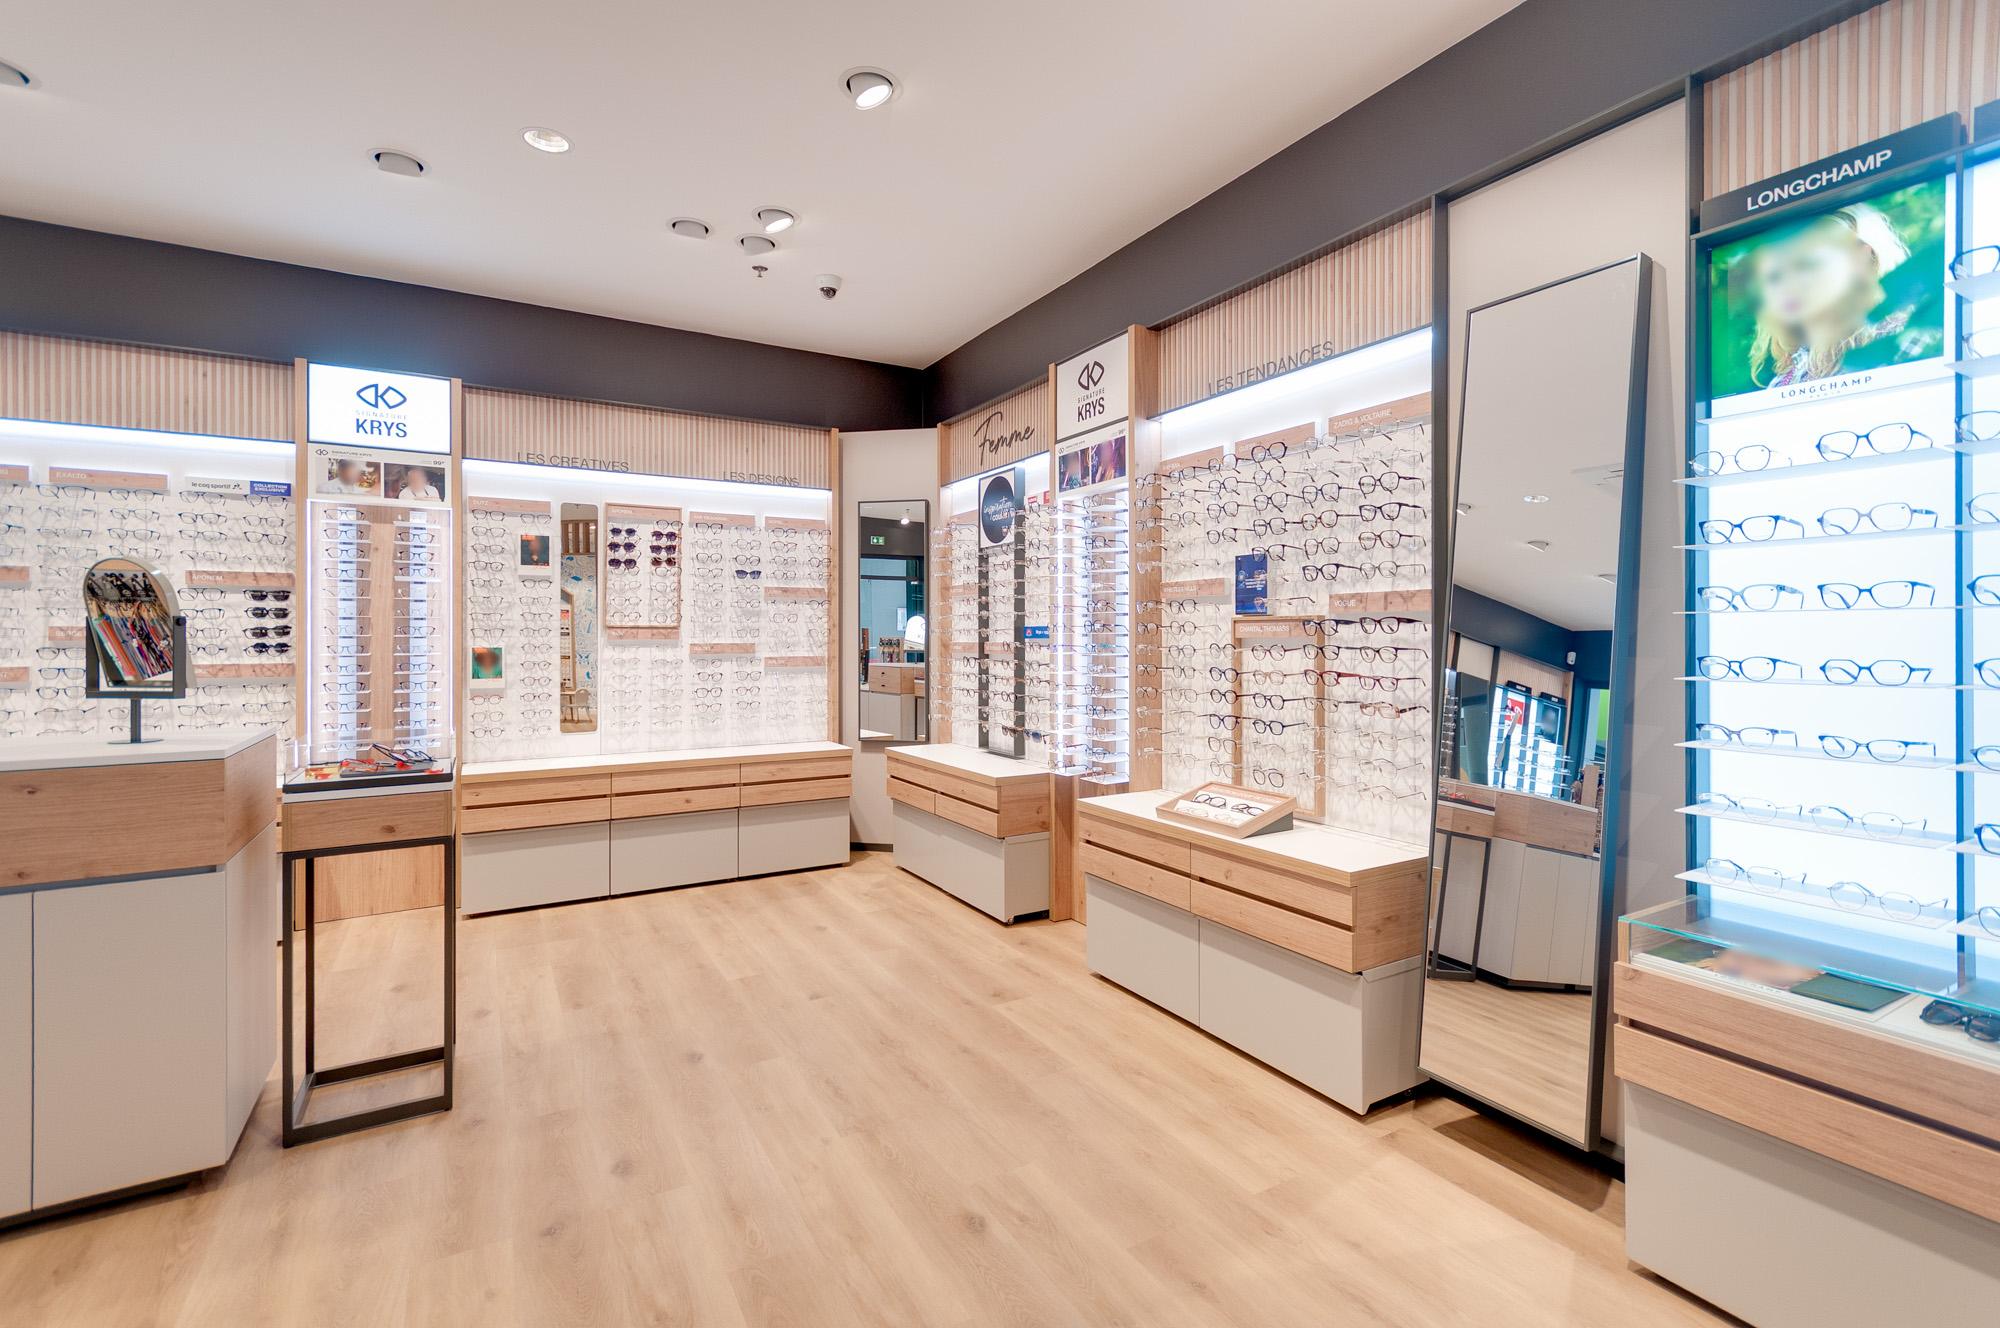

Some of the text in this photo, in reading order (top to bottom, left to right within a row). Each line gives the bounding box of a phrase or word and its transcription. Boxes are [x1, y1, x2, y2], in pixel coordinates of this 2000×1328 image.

[1746, 149, 1893, 211] LONGCHAMP
[1208, 340, 1334, 397] LES TENDANCES
[1077, 386, 1105, 404] SIGNATURE
[1781, 375, 1873, 399] LONGCHAMP
[355, 409, 408, 421] SIGNATURE
[1077, 396, 1105, 423] KRYS
[355, 417, 408, 438] KRYS
[973, 411, 1035, 466] Femme
[517, 452, 546, 465] LES
[723, 471, 800, 487] LES DESIGNS
[1334, 599, 1357, 608] VOGUE
